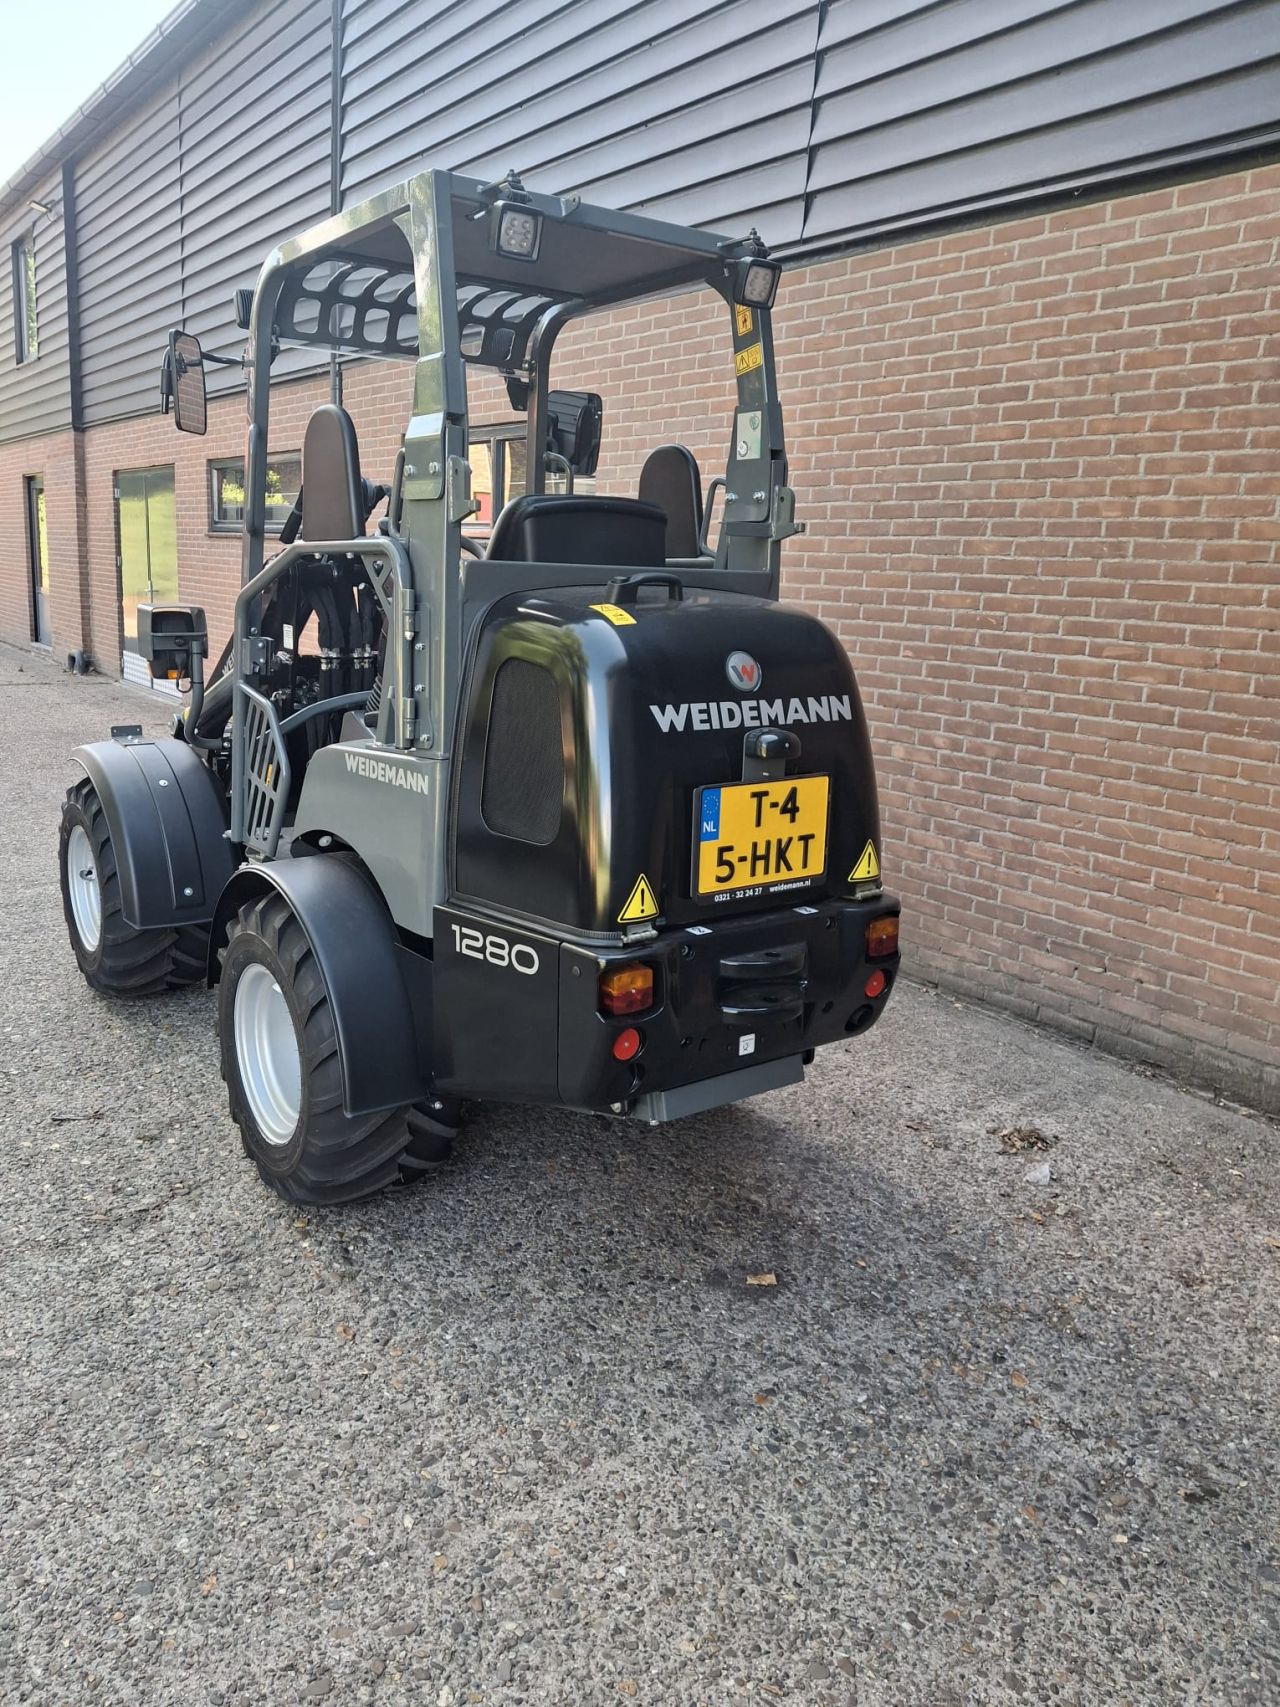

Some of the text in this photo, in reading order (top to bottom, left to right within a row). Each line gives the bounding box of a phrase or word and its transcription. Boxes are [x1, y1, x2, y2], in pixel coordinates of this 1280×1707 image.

[649, 694, 852, 733] WEIDEMANN
[344, 752, 429, 795] WEIDEMANN
[703, 821, 717, 833] NL
[750, 786, 800, 828] T-4
[715, 833, 816, 884] 5-HKT
[714, 893, 730, 902] 0321
[735, 891, 744, 899] 32
[745, 889, 753, 897] 24
[754, 887, 763, 896] 27
[769, 878, 811, 893] weidemann.nl
[451, 923, 540, 975] 1280
